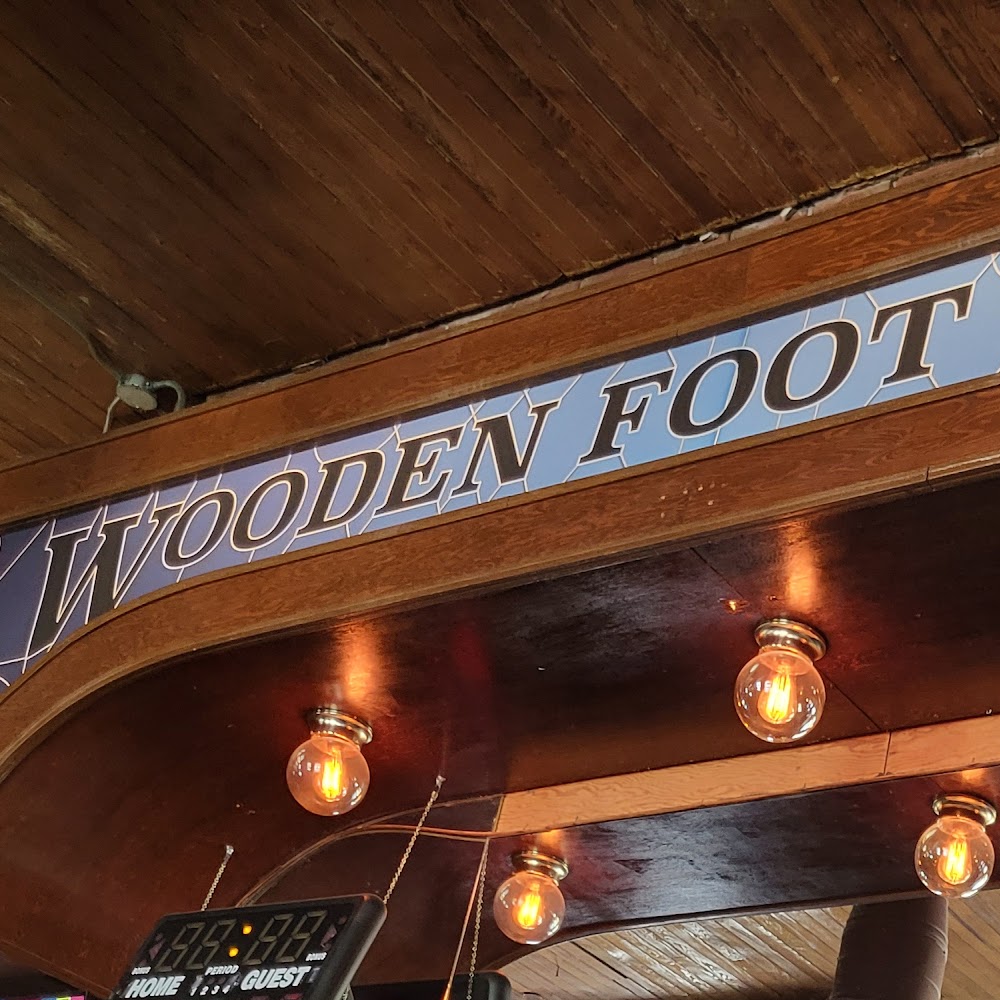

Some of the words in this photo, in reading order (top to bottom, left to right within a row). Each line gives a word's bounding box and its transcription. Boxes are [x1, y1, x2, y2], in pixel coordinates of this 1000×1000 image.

[28, 402, 563, 651] WOODEN
[581, 285, 972, 464] FOOT
[124, 975, 186, 999] HOME
[240, 966, 312, 992] GUEST
[204, 965, 240, 977] PERIOD
